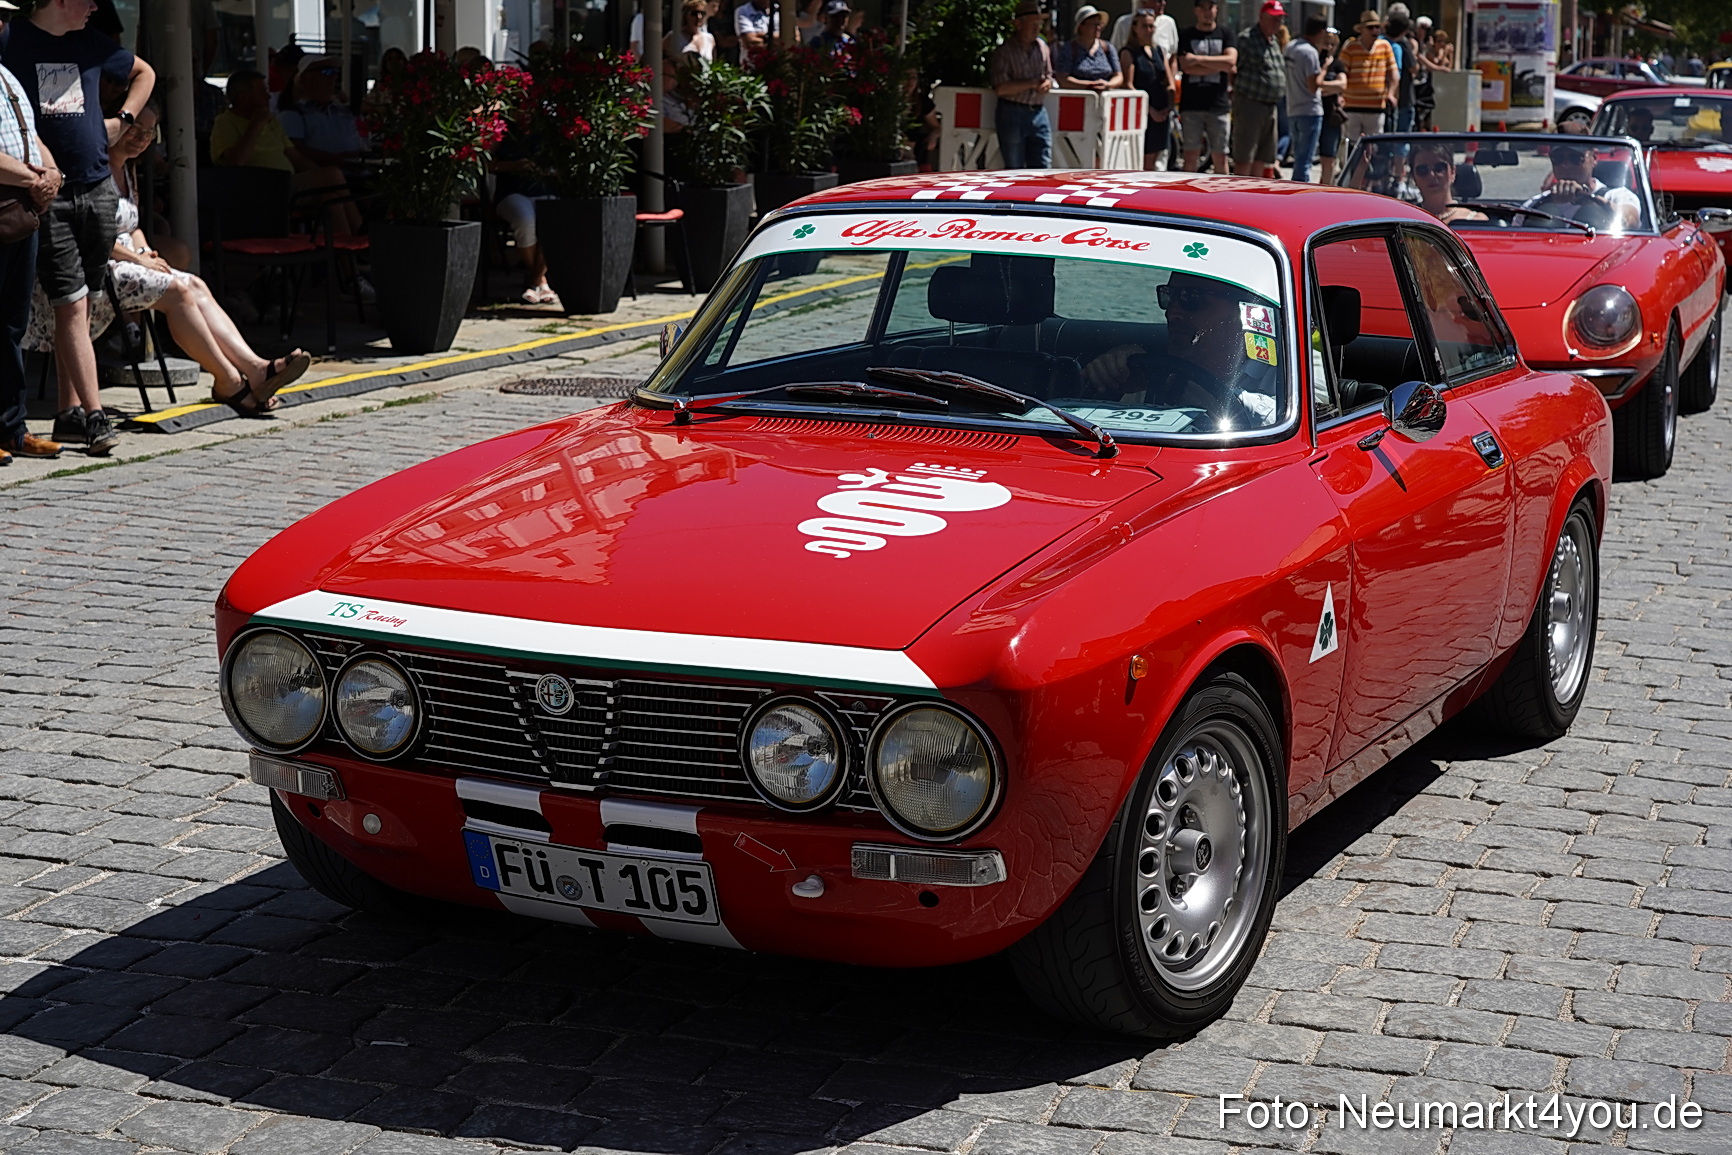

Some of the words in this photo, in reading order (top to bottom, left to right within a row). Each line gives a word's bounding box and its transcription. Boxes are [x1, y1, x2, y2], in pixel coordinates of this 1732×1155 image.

[840, 219, 926, 246] Alfa
[928, 218, 1053, 243] Romeo
[1059, 226, 1151, 252] Corse
[1255, 346, 1269, 360] 23
[1105, 410, 1164, 422] 295
[327, 601, 365, 619] TS
[357, 610, 408, 628] Racing
[479, 865, 490, 879] D
[495, 842, 555, 895] FÜ
[578, 857, 605, 903] T
[618, 864, 708, 916] 105
